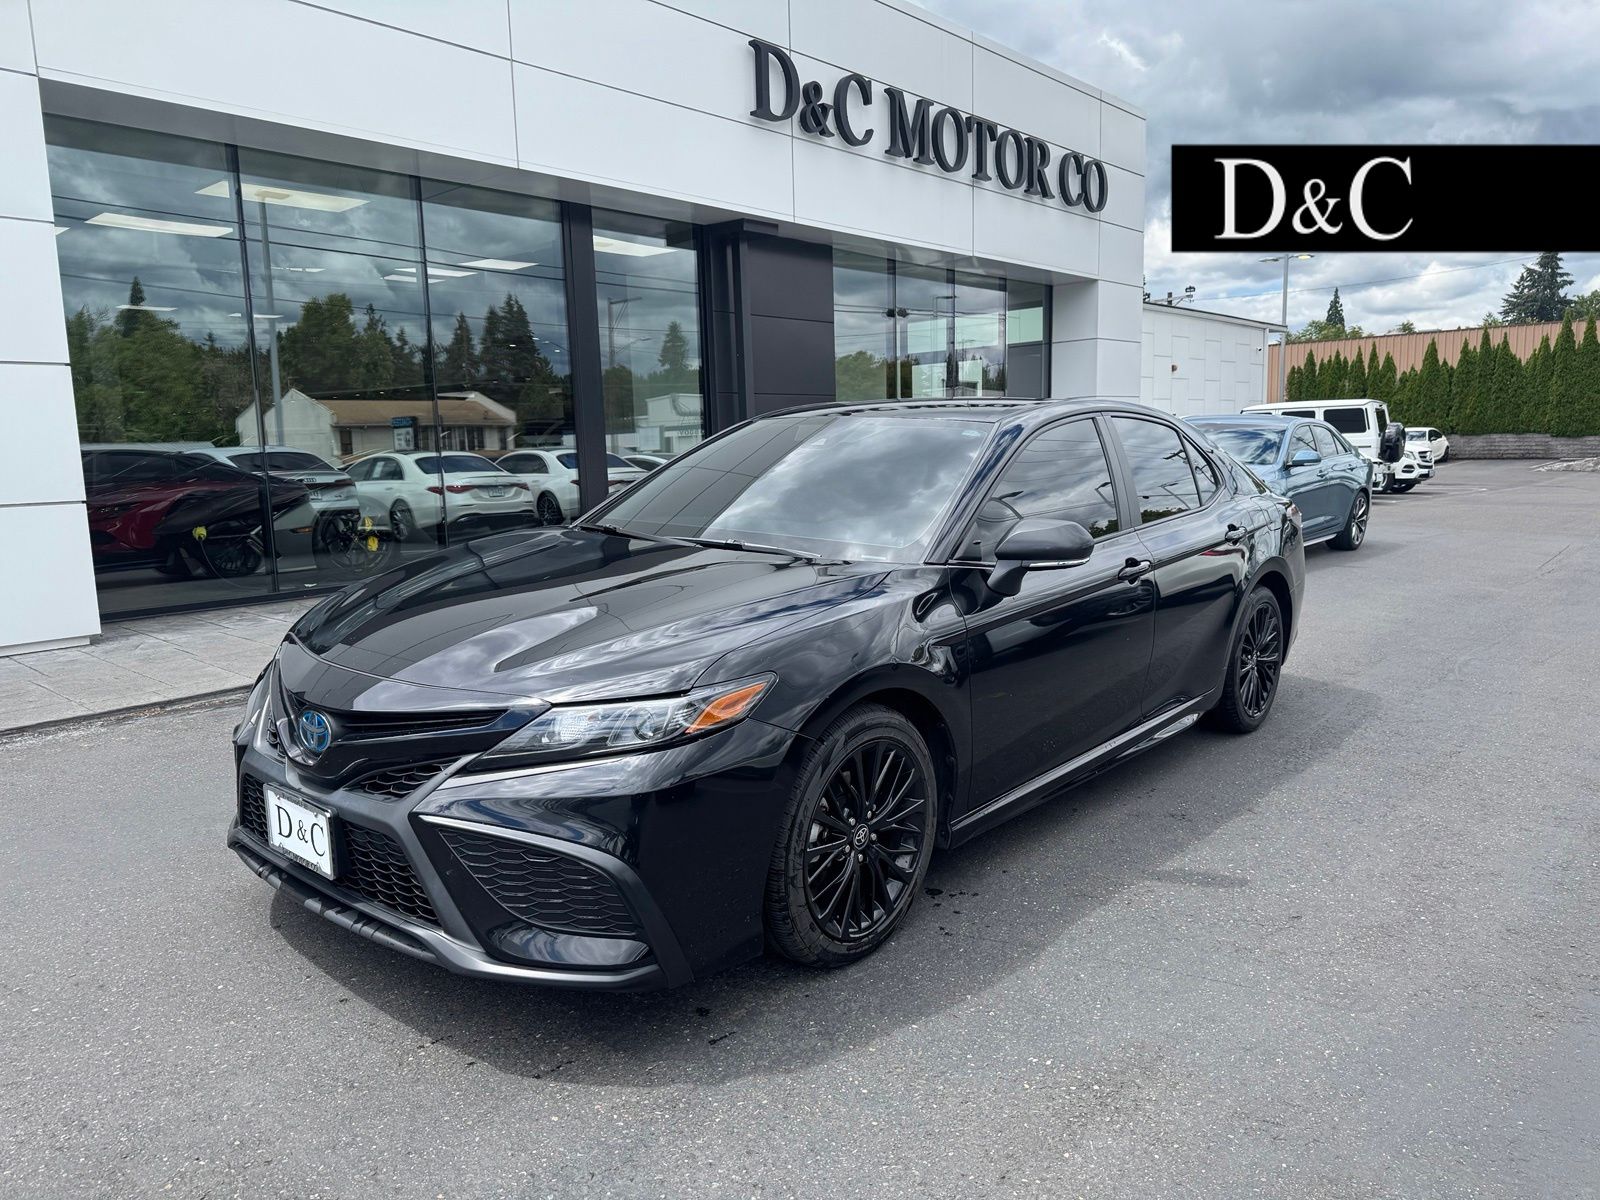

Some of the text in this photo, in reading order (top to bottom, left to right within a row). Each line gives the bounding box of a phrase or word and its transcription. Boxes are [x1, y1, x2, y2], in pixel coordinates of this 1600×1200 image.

[749, 40, 1108, 213] D&C MOTOR CO
